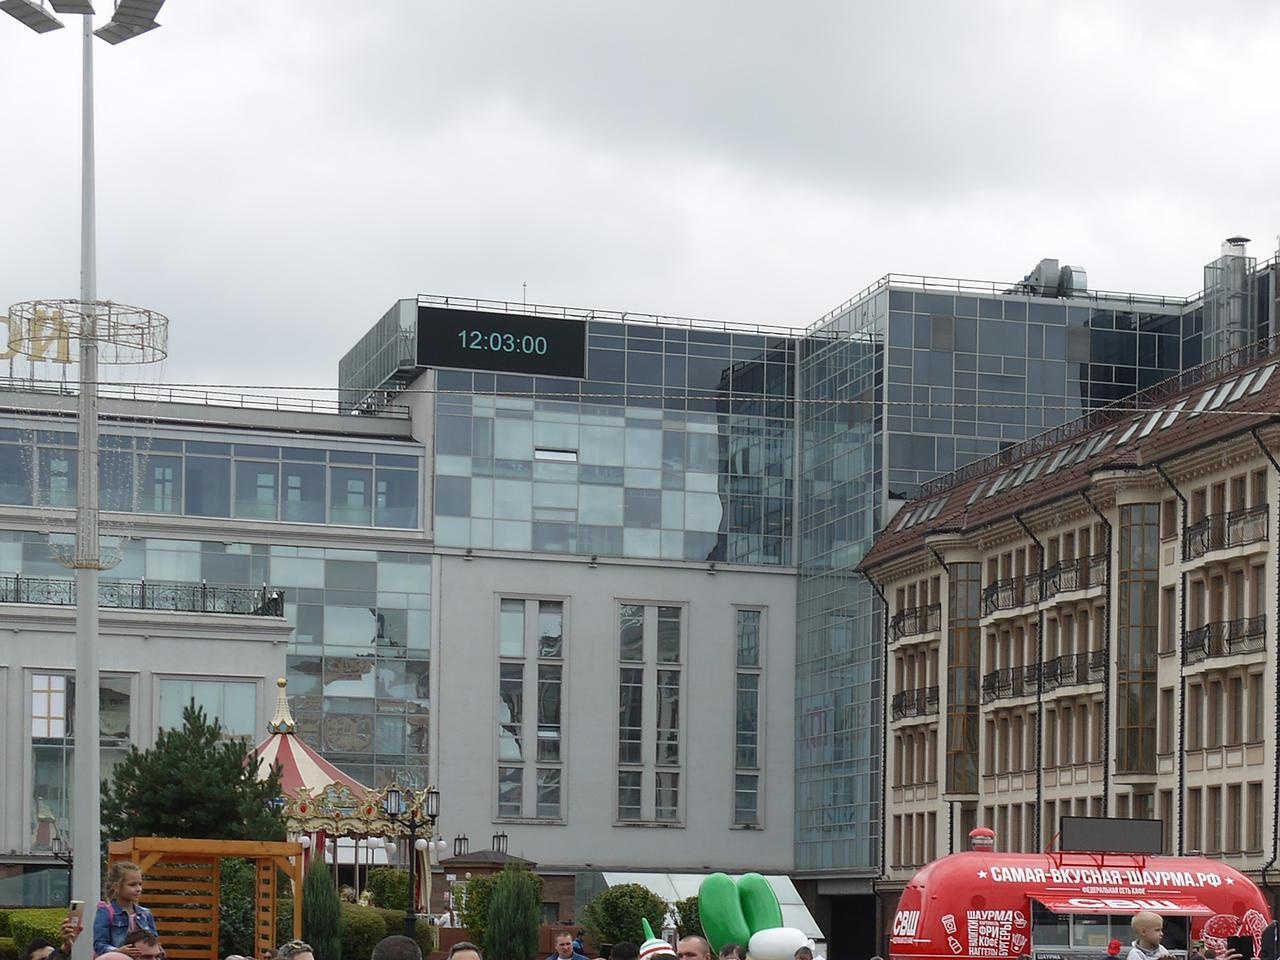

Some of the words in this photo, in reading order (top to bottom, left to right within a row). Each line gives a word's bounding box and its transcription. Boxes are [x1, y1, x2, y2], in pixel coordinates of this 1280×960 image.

[458, 330, 548, 355] 12:03:00
[990, 866, 1221, 888] САМАЯ-ВКУСНАЯ-ШАУРМА.РФ
[1068, 899, 1181, 910] СВШ
[967, 910, 1013, 920] ШАУРМА
[893, 911, 920, 936] СВШ
[979, 926, 999, 938] ФРИ
[979, 938, 999, 947] КОФЕ
